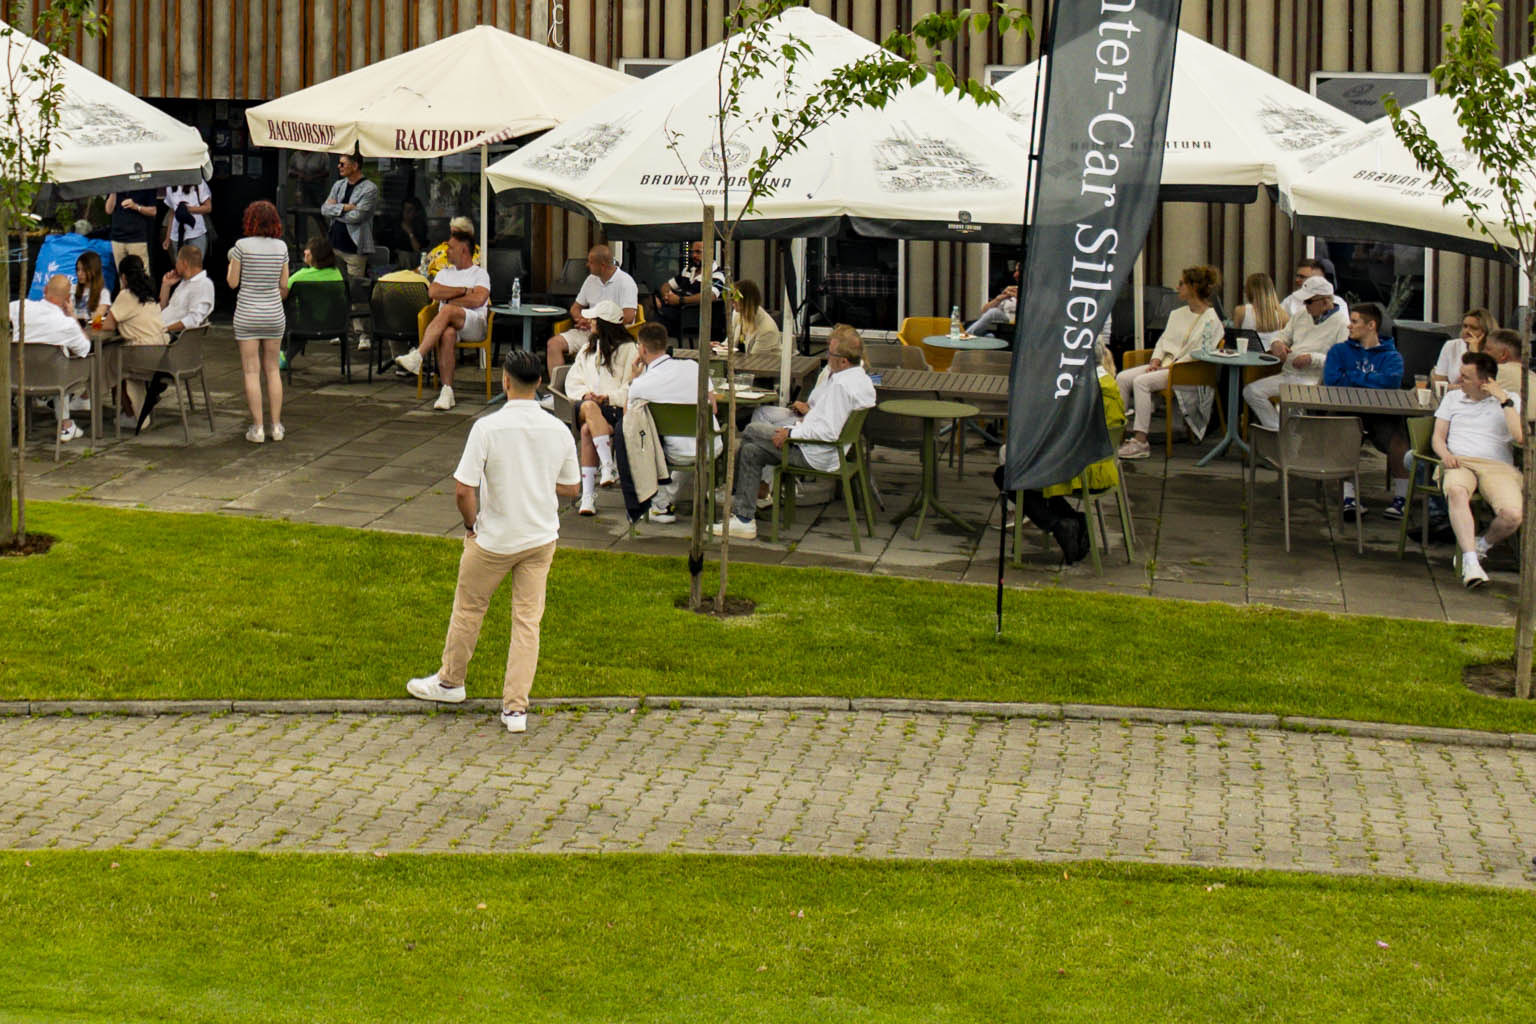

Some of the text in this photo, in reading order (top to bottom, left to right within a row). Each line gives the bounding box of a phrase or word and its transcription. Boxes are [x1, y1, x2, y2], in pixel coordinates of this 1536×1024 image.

[267, 119, 336, 146] RACIBORSKIE
[639, 174, 711, 187] BROWAR
[1352, 169, 1420, 188] BROWAR
[1054, 223, 1119, 400] Silesia
